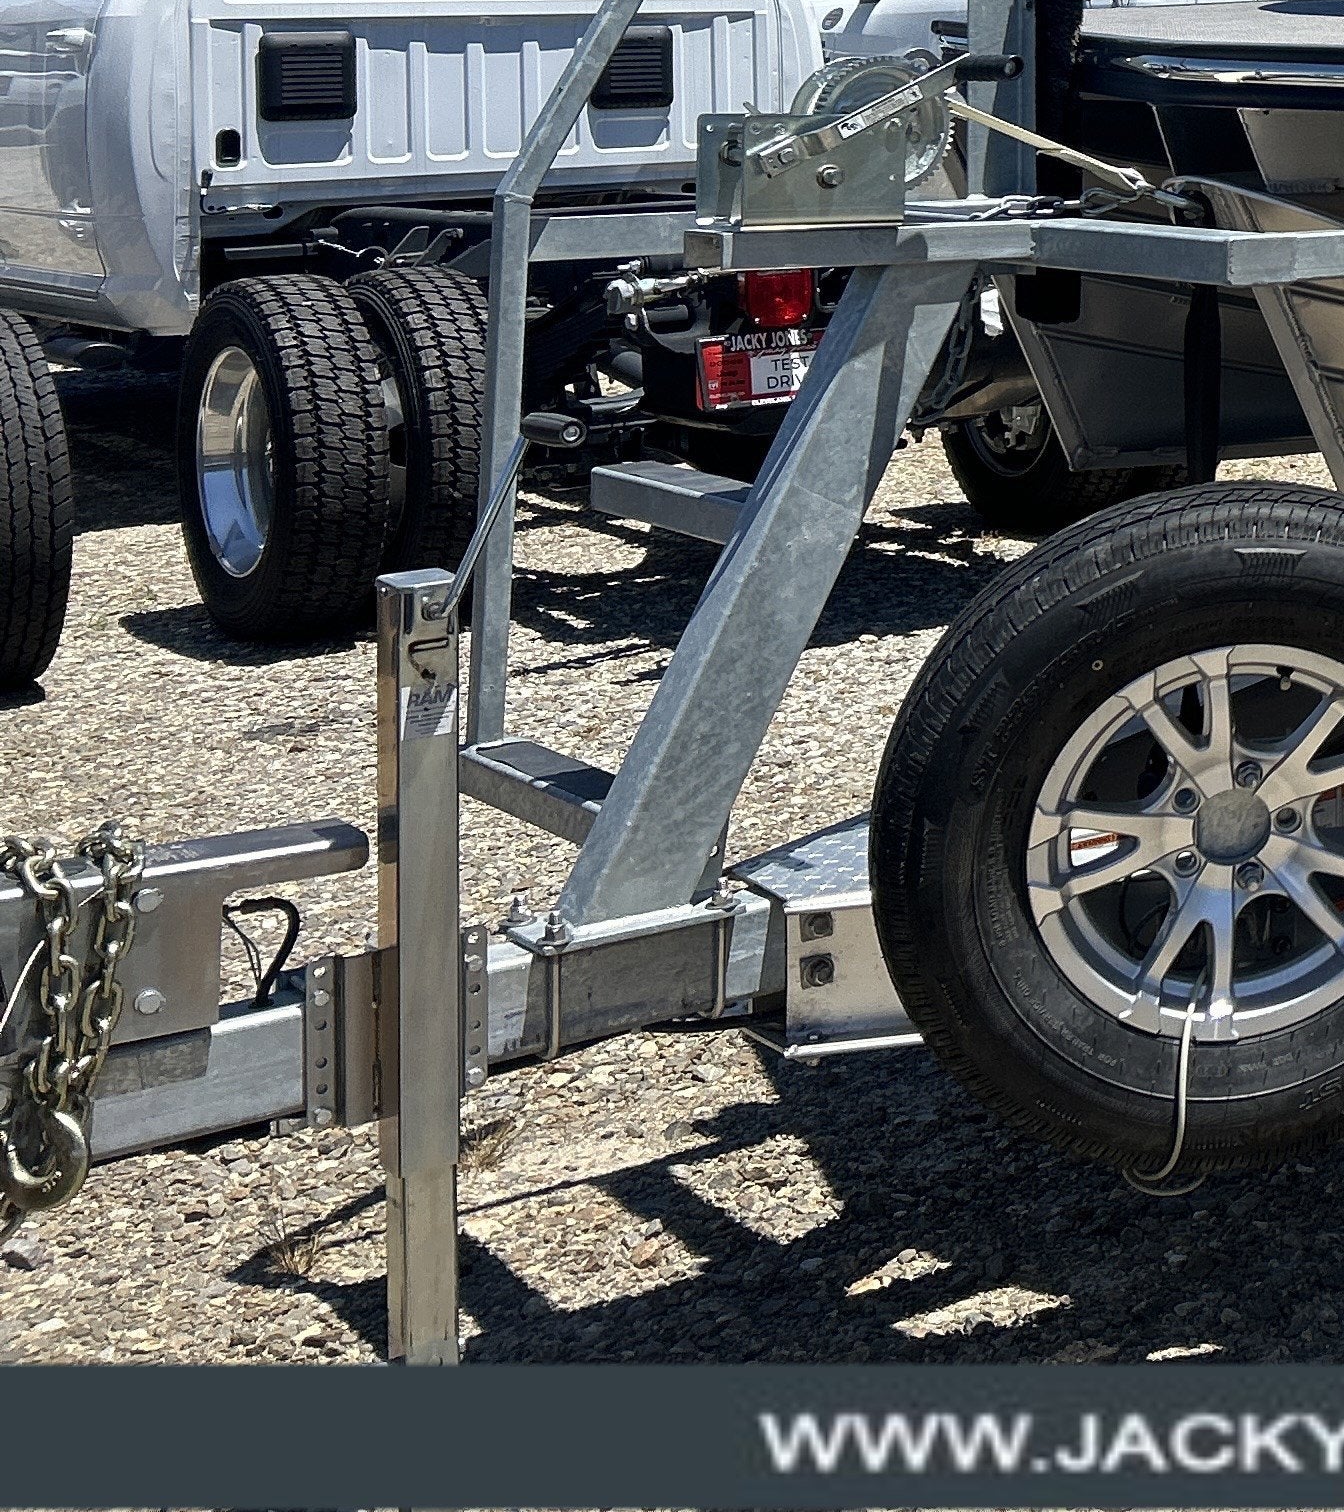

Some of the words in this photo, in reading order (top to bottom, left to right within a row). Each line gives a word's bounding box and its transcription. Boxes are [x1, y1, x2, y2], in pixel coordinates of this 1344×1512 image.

[731, 331, 768, 352] JACKY
[771, 327, 808, 349] JONES
[772, 355, 809, 372] TEST
[767, 373, 801, 390] DRI
